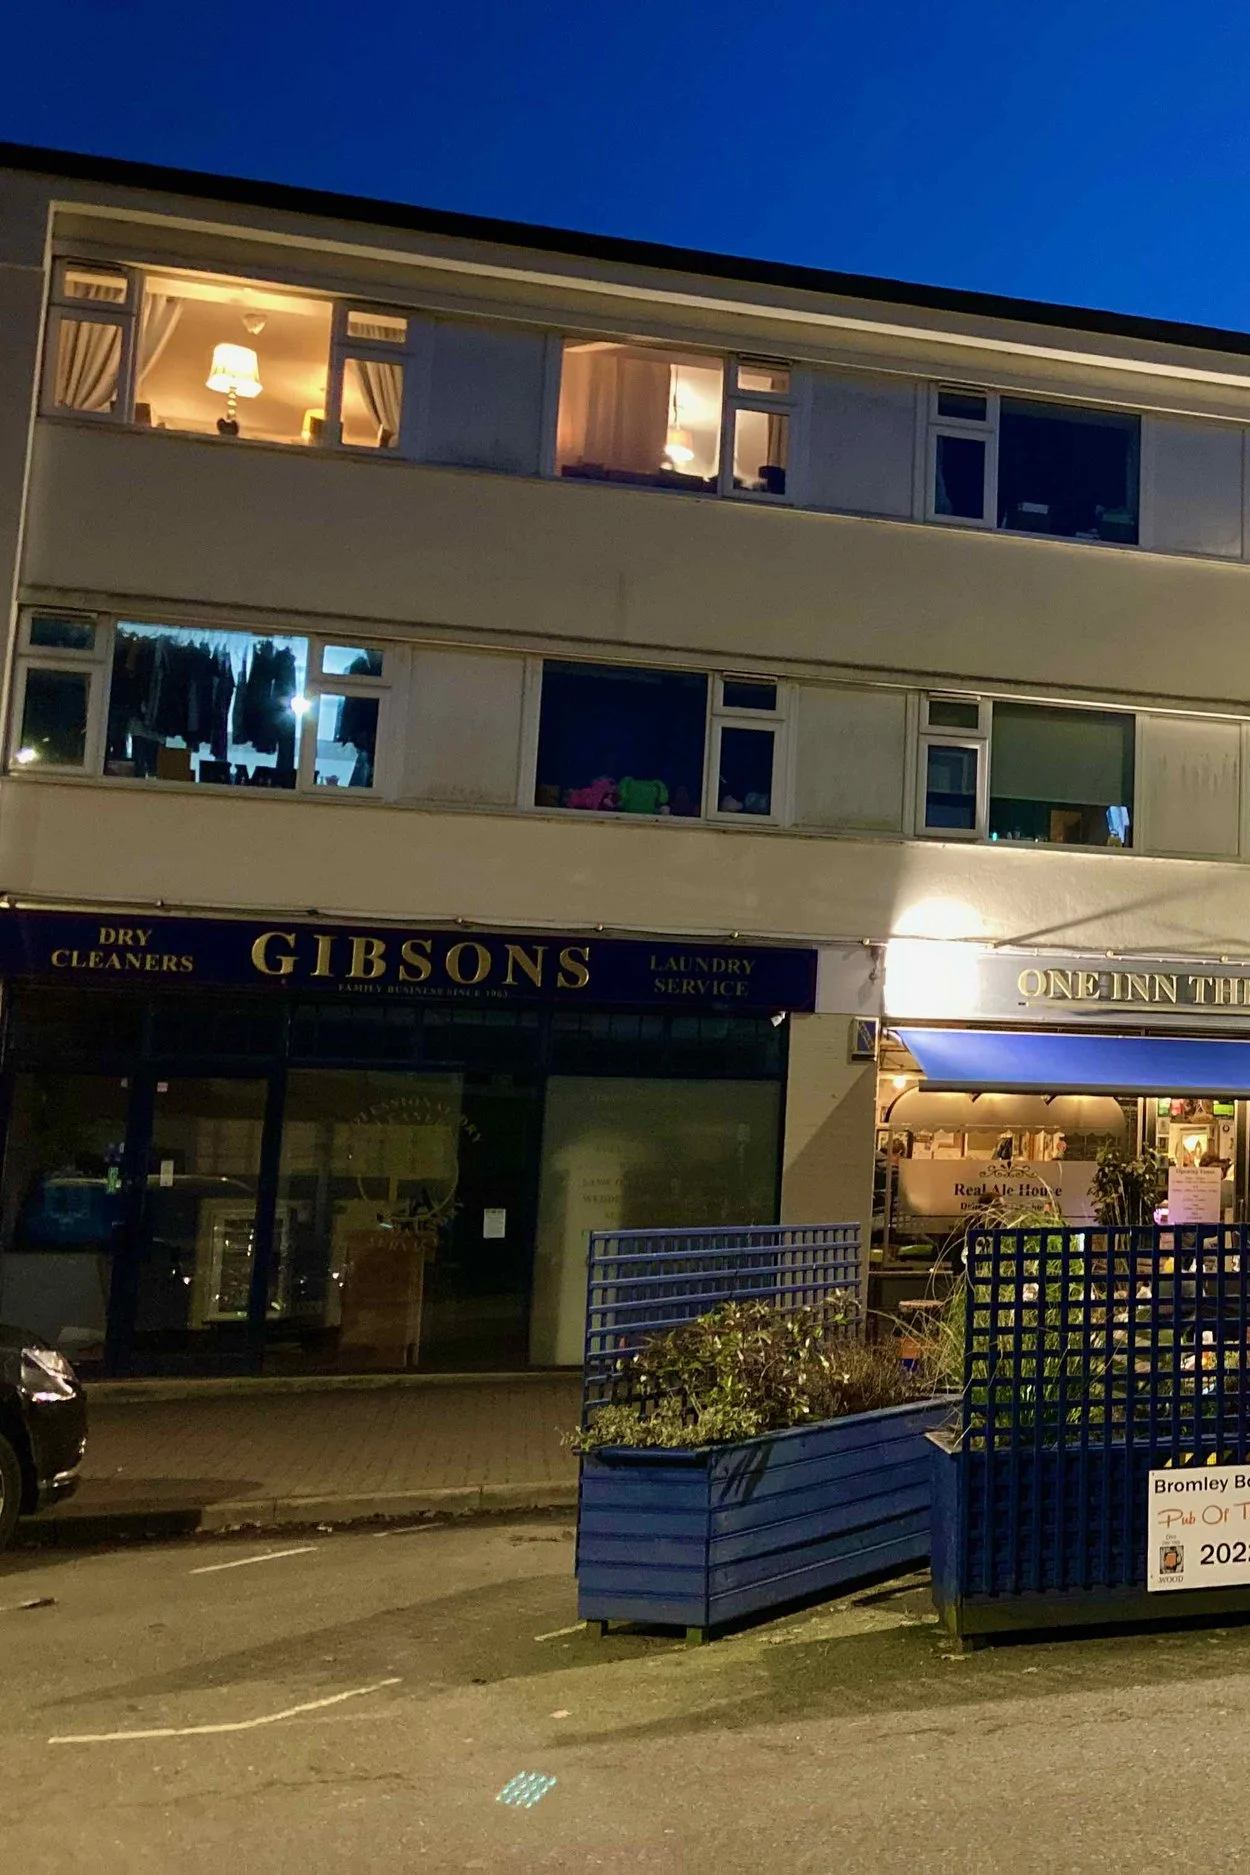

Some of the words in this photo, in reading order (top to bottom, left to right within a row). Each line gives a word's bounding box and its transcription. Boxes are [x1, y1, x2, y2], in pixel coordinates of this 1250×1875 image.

[100, 927, 152, 946] DRY
[51, 949, 194, 972] CLEANERS
[251, 930, 591, 989] GIBSONS
[650, 955, 756, 975] LAUNDRY
[654, 978, 750, 996] SERVICE
[1018, 968, 1101, 1000] ONE
[1110, 972, 1179, 1003] INN
[954, 1183, 986, 1196] Real
[992, 1184, 1014, 1197] Ale
[1155, 1477, 1229, 1494] Bromley
[1157, 1508, 1196, 1529] Pub
[1202, 1504, 1229, 1525] Of
